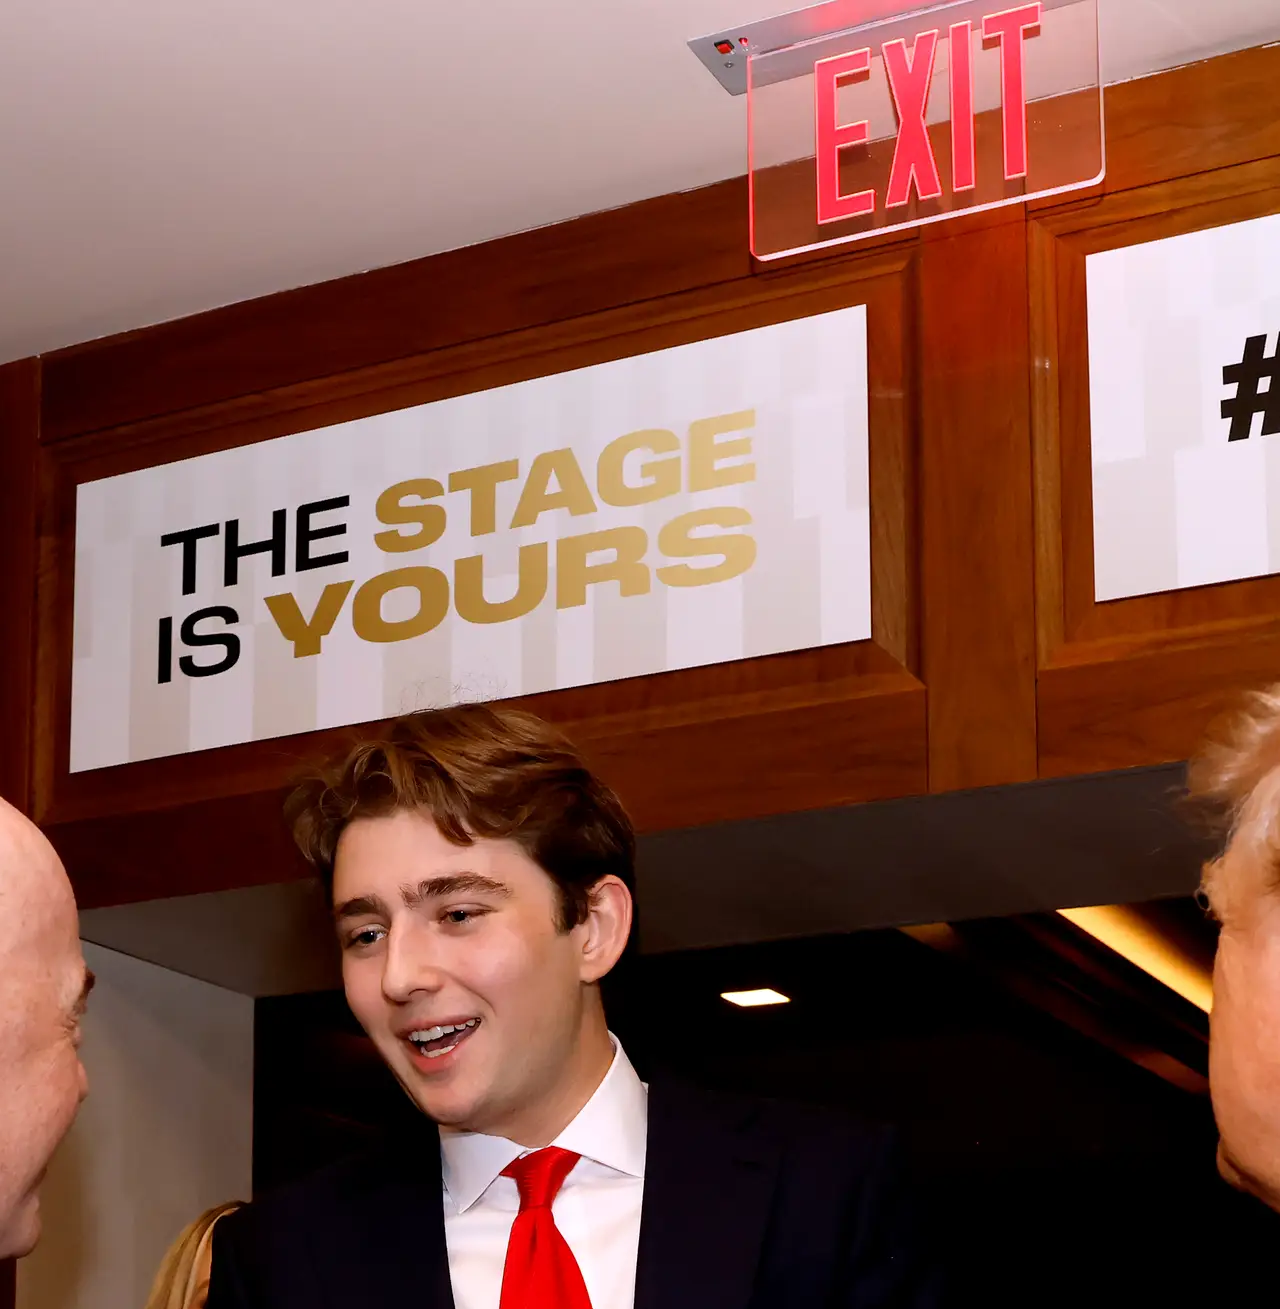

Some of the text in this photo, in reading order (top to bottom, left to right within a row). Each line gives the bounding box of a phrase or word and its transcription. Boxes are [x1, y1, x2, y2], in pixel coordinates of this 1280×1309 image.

[814, 2, 1041, 225] EXIT
[157, 507, 757, 684] IS YOURS
[161, 409, 756, 596] THE STAGE
